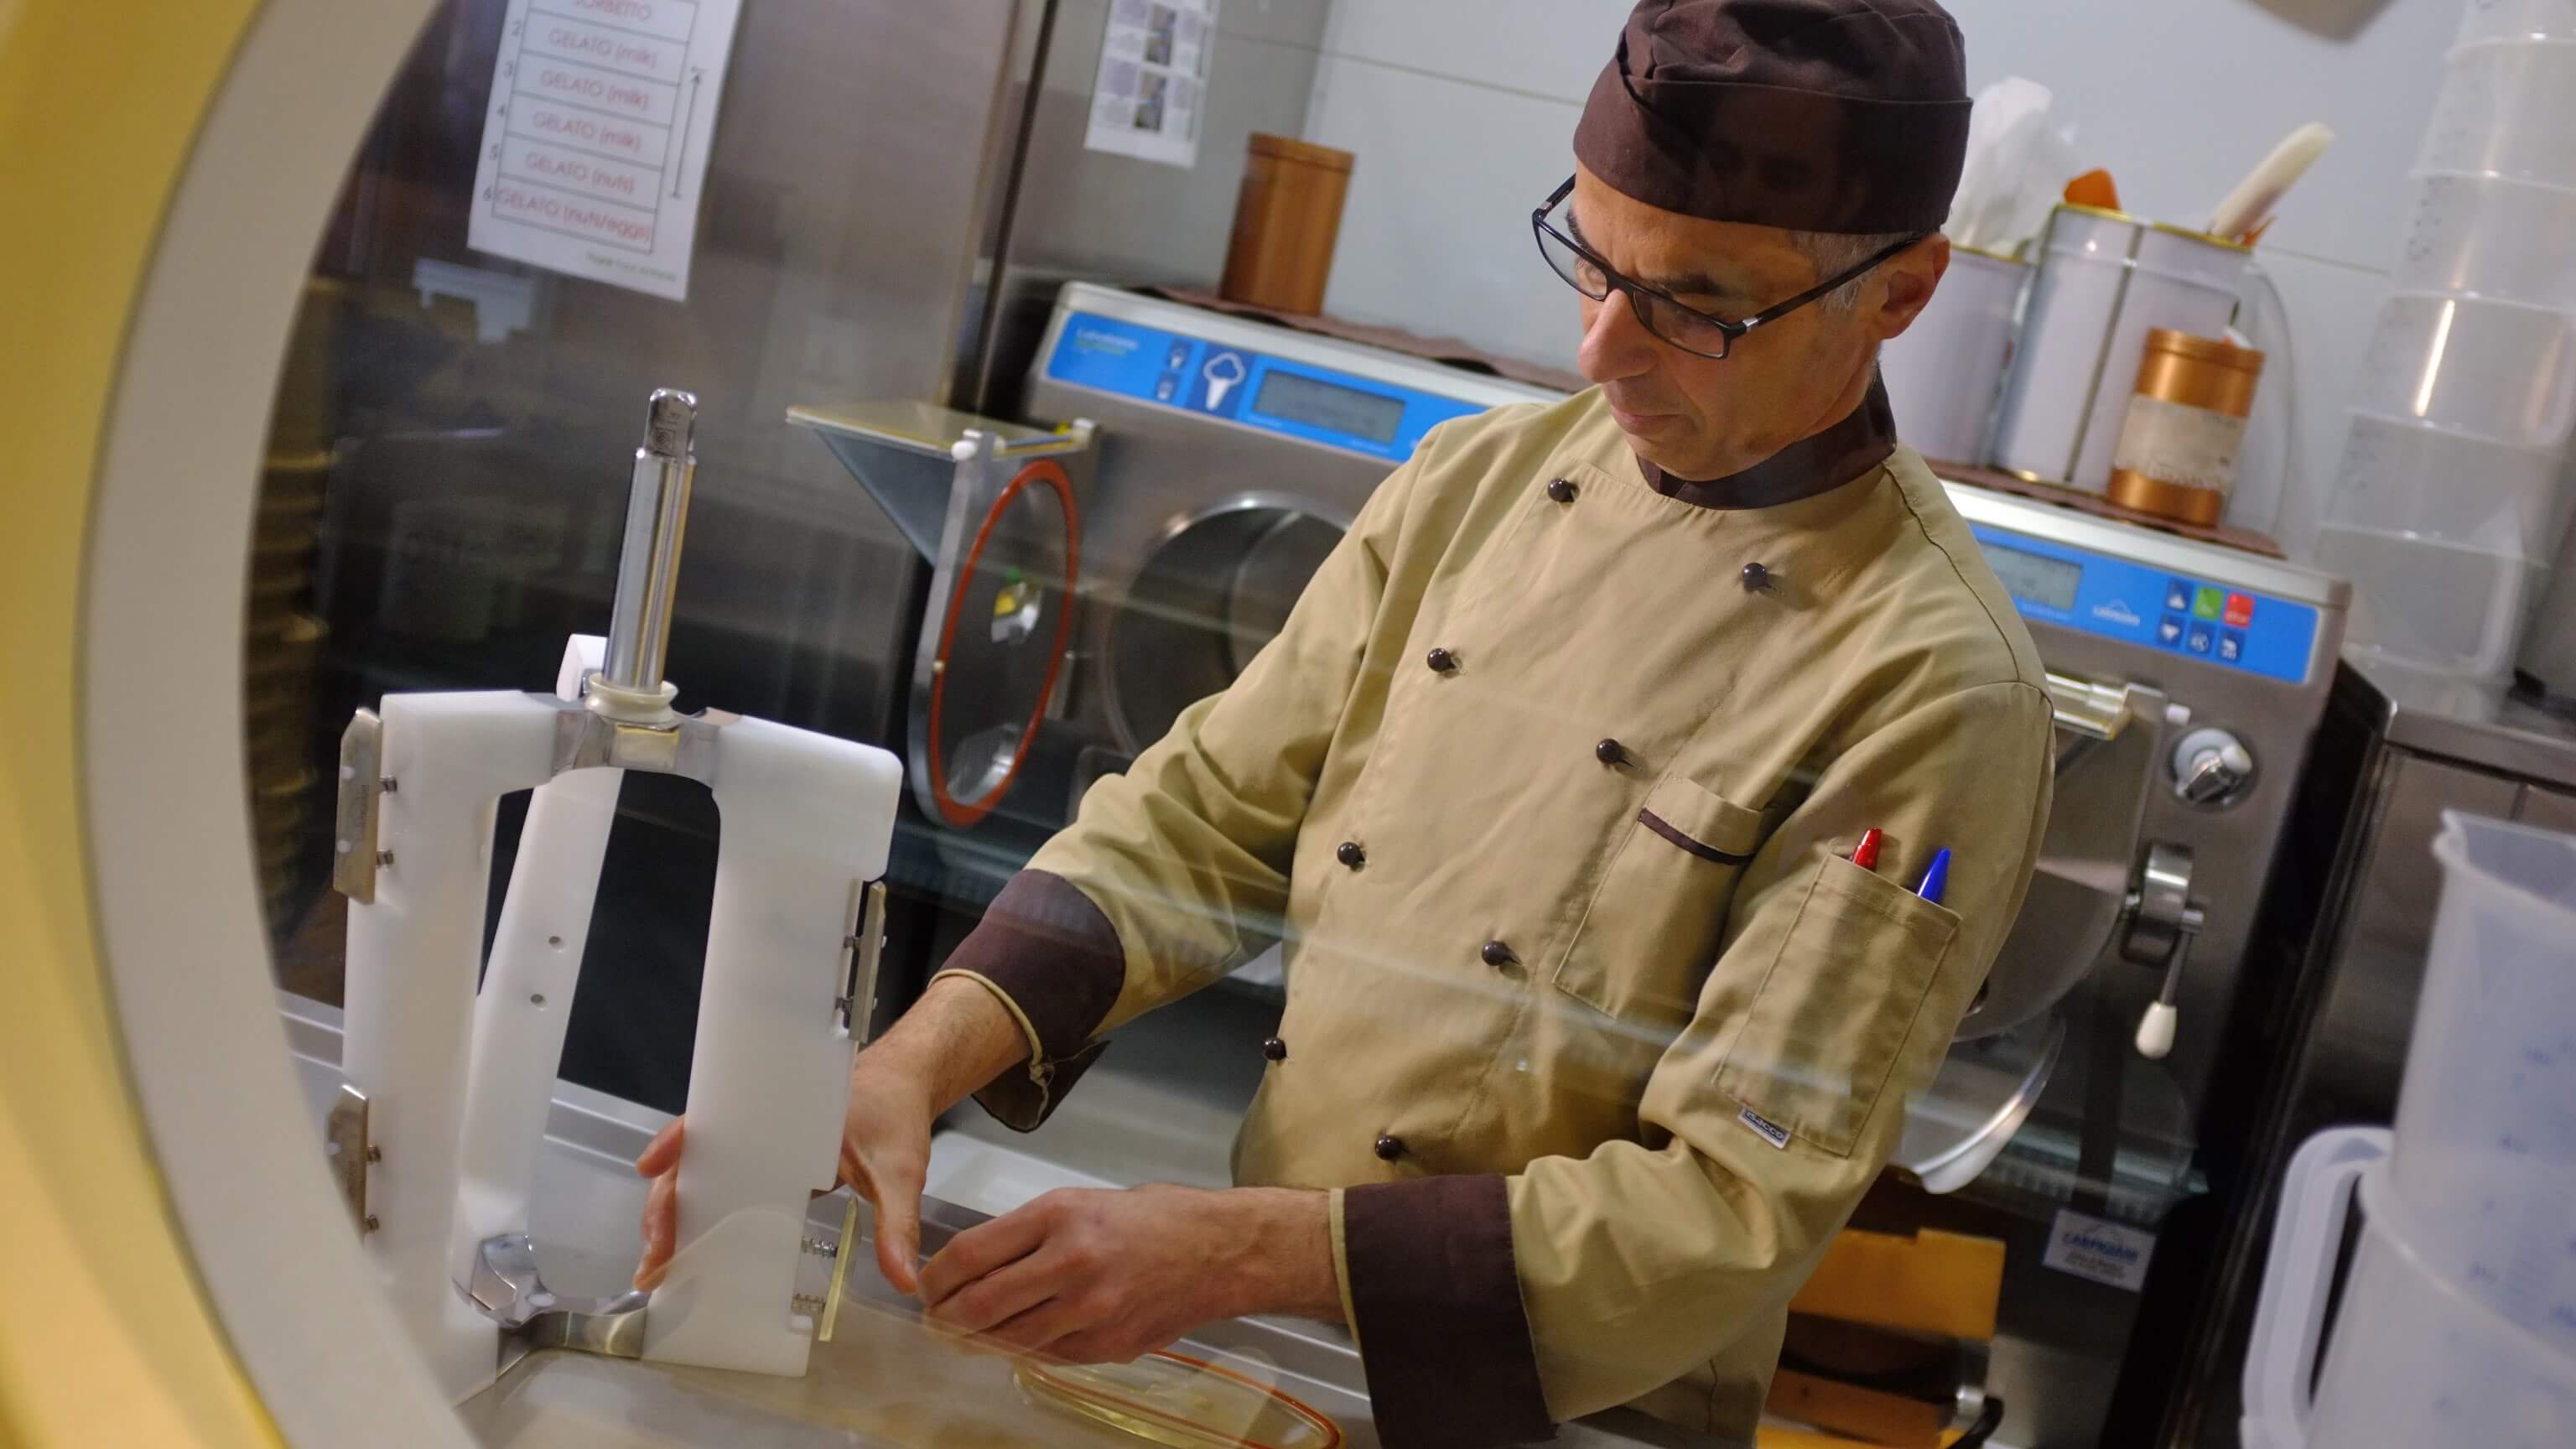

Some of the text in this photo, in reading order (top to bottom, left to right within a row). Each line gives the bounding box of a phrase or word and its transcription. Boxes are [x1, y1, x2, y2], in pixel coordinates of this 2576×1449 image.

[511, 20, 522, 36] 2
[548, 27, 611, 56] GELATO
[541, 69, 603, 97] GELATO
[533, 111, 595, 139] GELATO
[526, 152, 588, 181] GELATO
[591, 169, 634, 195] (nuts)
[496, 187, 559, 216] GELATO
